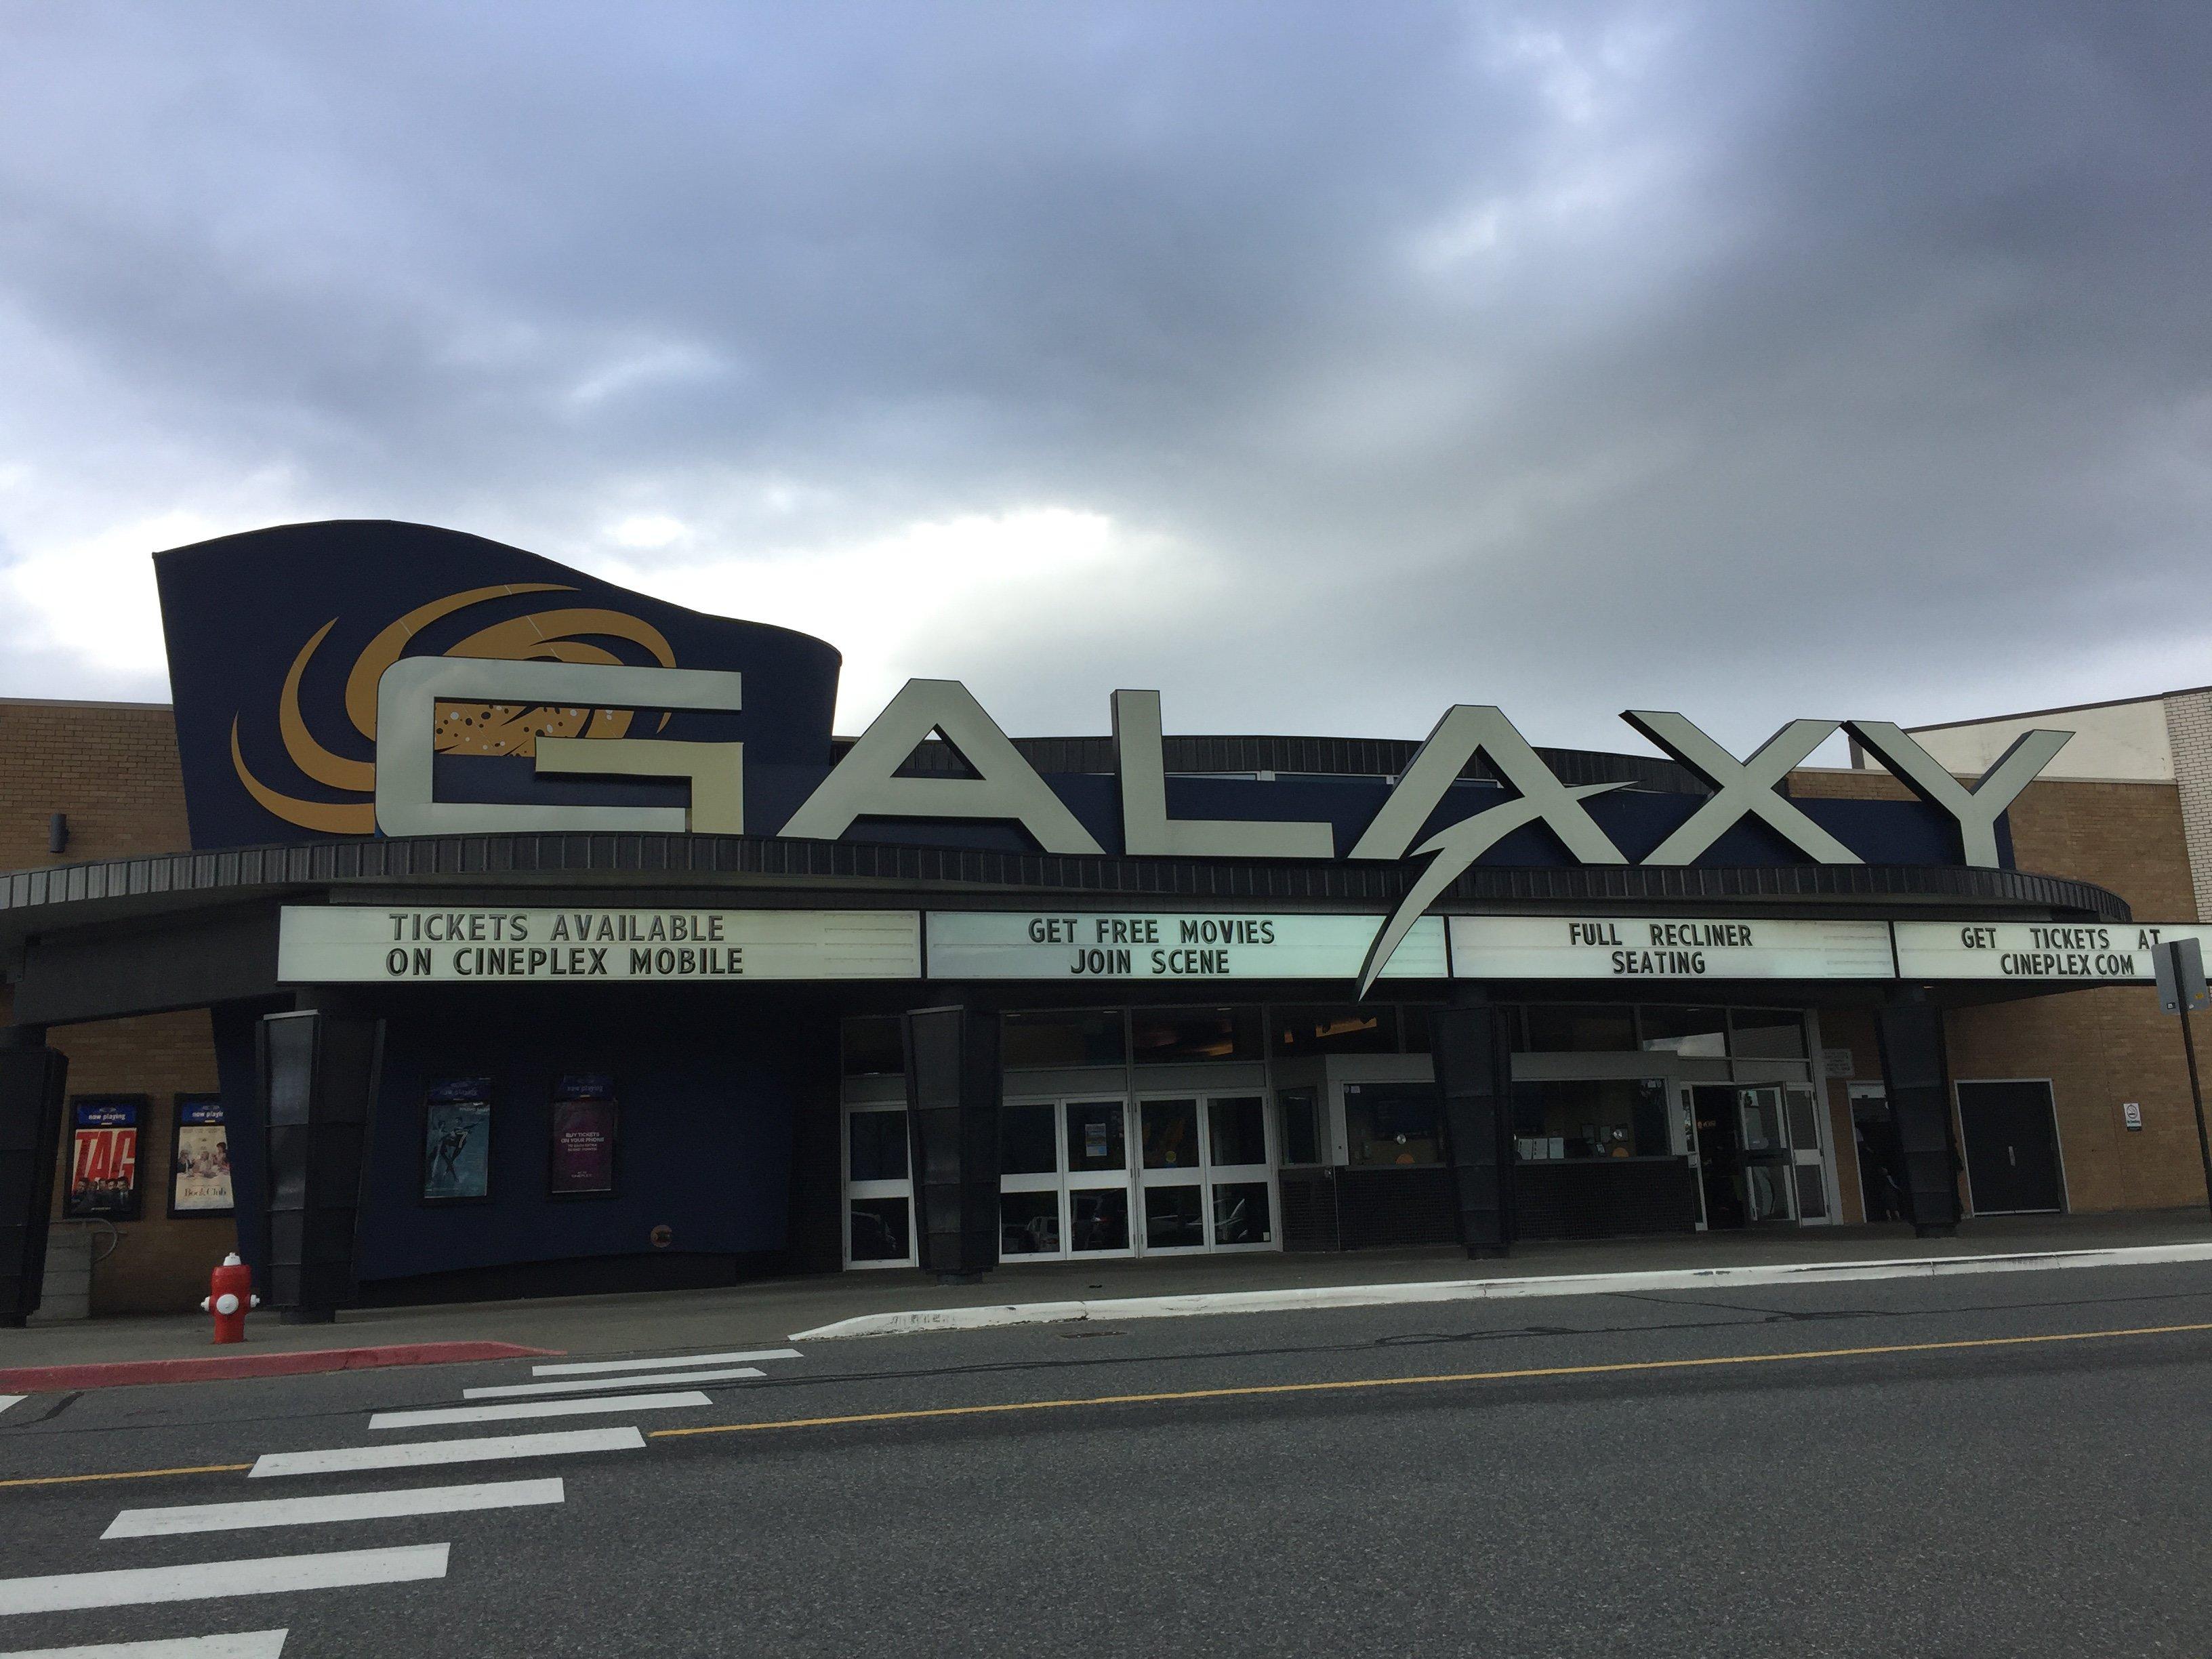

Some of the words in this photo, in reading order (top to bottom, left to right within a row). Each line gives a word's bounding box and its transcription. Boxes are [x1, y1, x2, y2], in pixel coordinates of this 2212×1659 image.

[373, 655, 2076, 1000] GALAXY
[389, 913, 528, 941] TICKETS
[550, 914, 724, 941] AVAILABLE
[1029, 918, 1078, 943] GET
[1095, 918, 1160, 944] FREE
[1179, 919, 1275, 945] MOVIES
[1568, 922, 1623, 946] FULL
[1649, 924, 1753, 947] RECLINER
[1961, 926, 1996, 949] GET
[2029, 927, 2110, 950] TICKETS
[2137, 928, 2161, 950] AT
[386, 947, 432, 977] ON
[453, 947, 609, 976] CINEPLEX
[630, 947, 743, 975] MOBILE
[1069, 948, 1131, 975] JOIN
[1151, 949, 1230, 975] SCENE
[1612, 950, 1706, 975] SEATING
[71, 1130, 137, 1194] TAG
[184, 1187, 205, 1197] Book
[206, 1187, 227, 1196] Club
